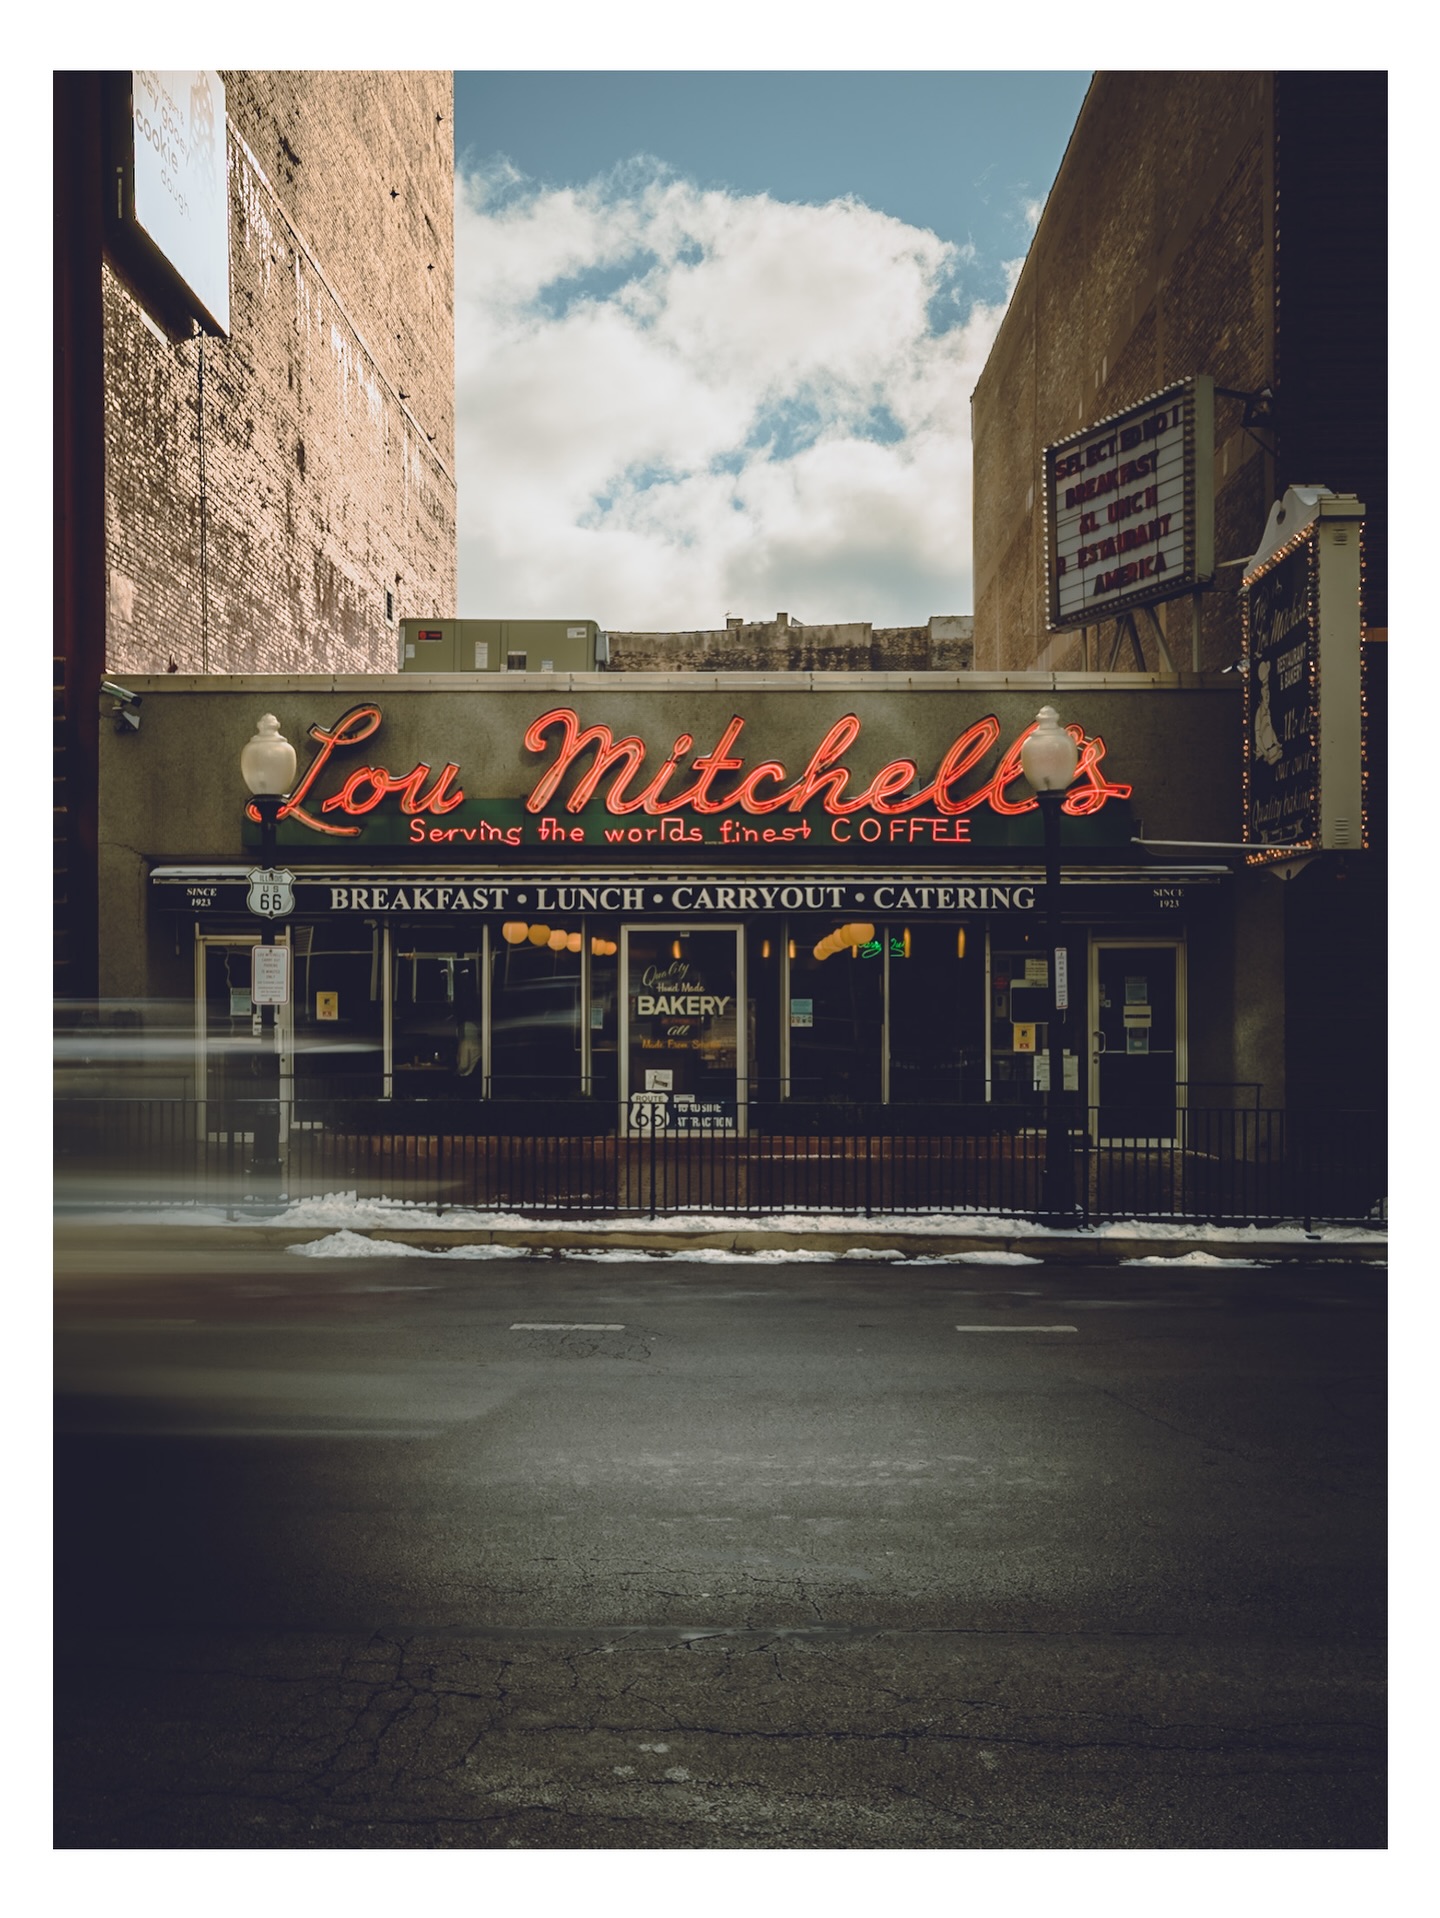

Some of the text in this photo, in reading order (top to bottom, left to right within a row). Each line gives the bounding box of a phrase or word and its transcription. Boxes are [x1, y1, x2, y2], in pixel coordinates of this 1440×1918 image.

[135, 70, 159, 112] oey
[162, 106, 190, 167] gooey
[136, 108, 178, 175] cookie
[161, 167, 192, 221] dough
[1066, 449, 1159, 509] BREAKFAST
[1093, 552, 1166, 596] AMERICA
[1277, 642, 1307, 675] RESTAURANT
[244, 702, 1133, 838] Lou Mitchell's
[409, 817, 524, 845] Serving
[539, 817, 585, 842] the
[719, 817, 812, 845] finest
[832, 817, 972, 843] COFFEE
[186, 888, 217, 897] SINCE
[191, 898, 212, 907] 1923
[260, 894, 282, 911] 66
[331, 887, 1035, 910] BREAKFAST LUNCH CARRYOUT CATERING
[1153, 888, 1184, 897] SINCE
[1159, 899, 1180, 908] 1923
[642, 960, 690, 989] Quality
[681, 982, 706, 993] Made
[637, 995, 731, 1016] BAKERY
[635, 1095, 664, 1103] ROUTE
[635, 1104, 665, 1128] 66
